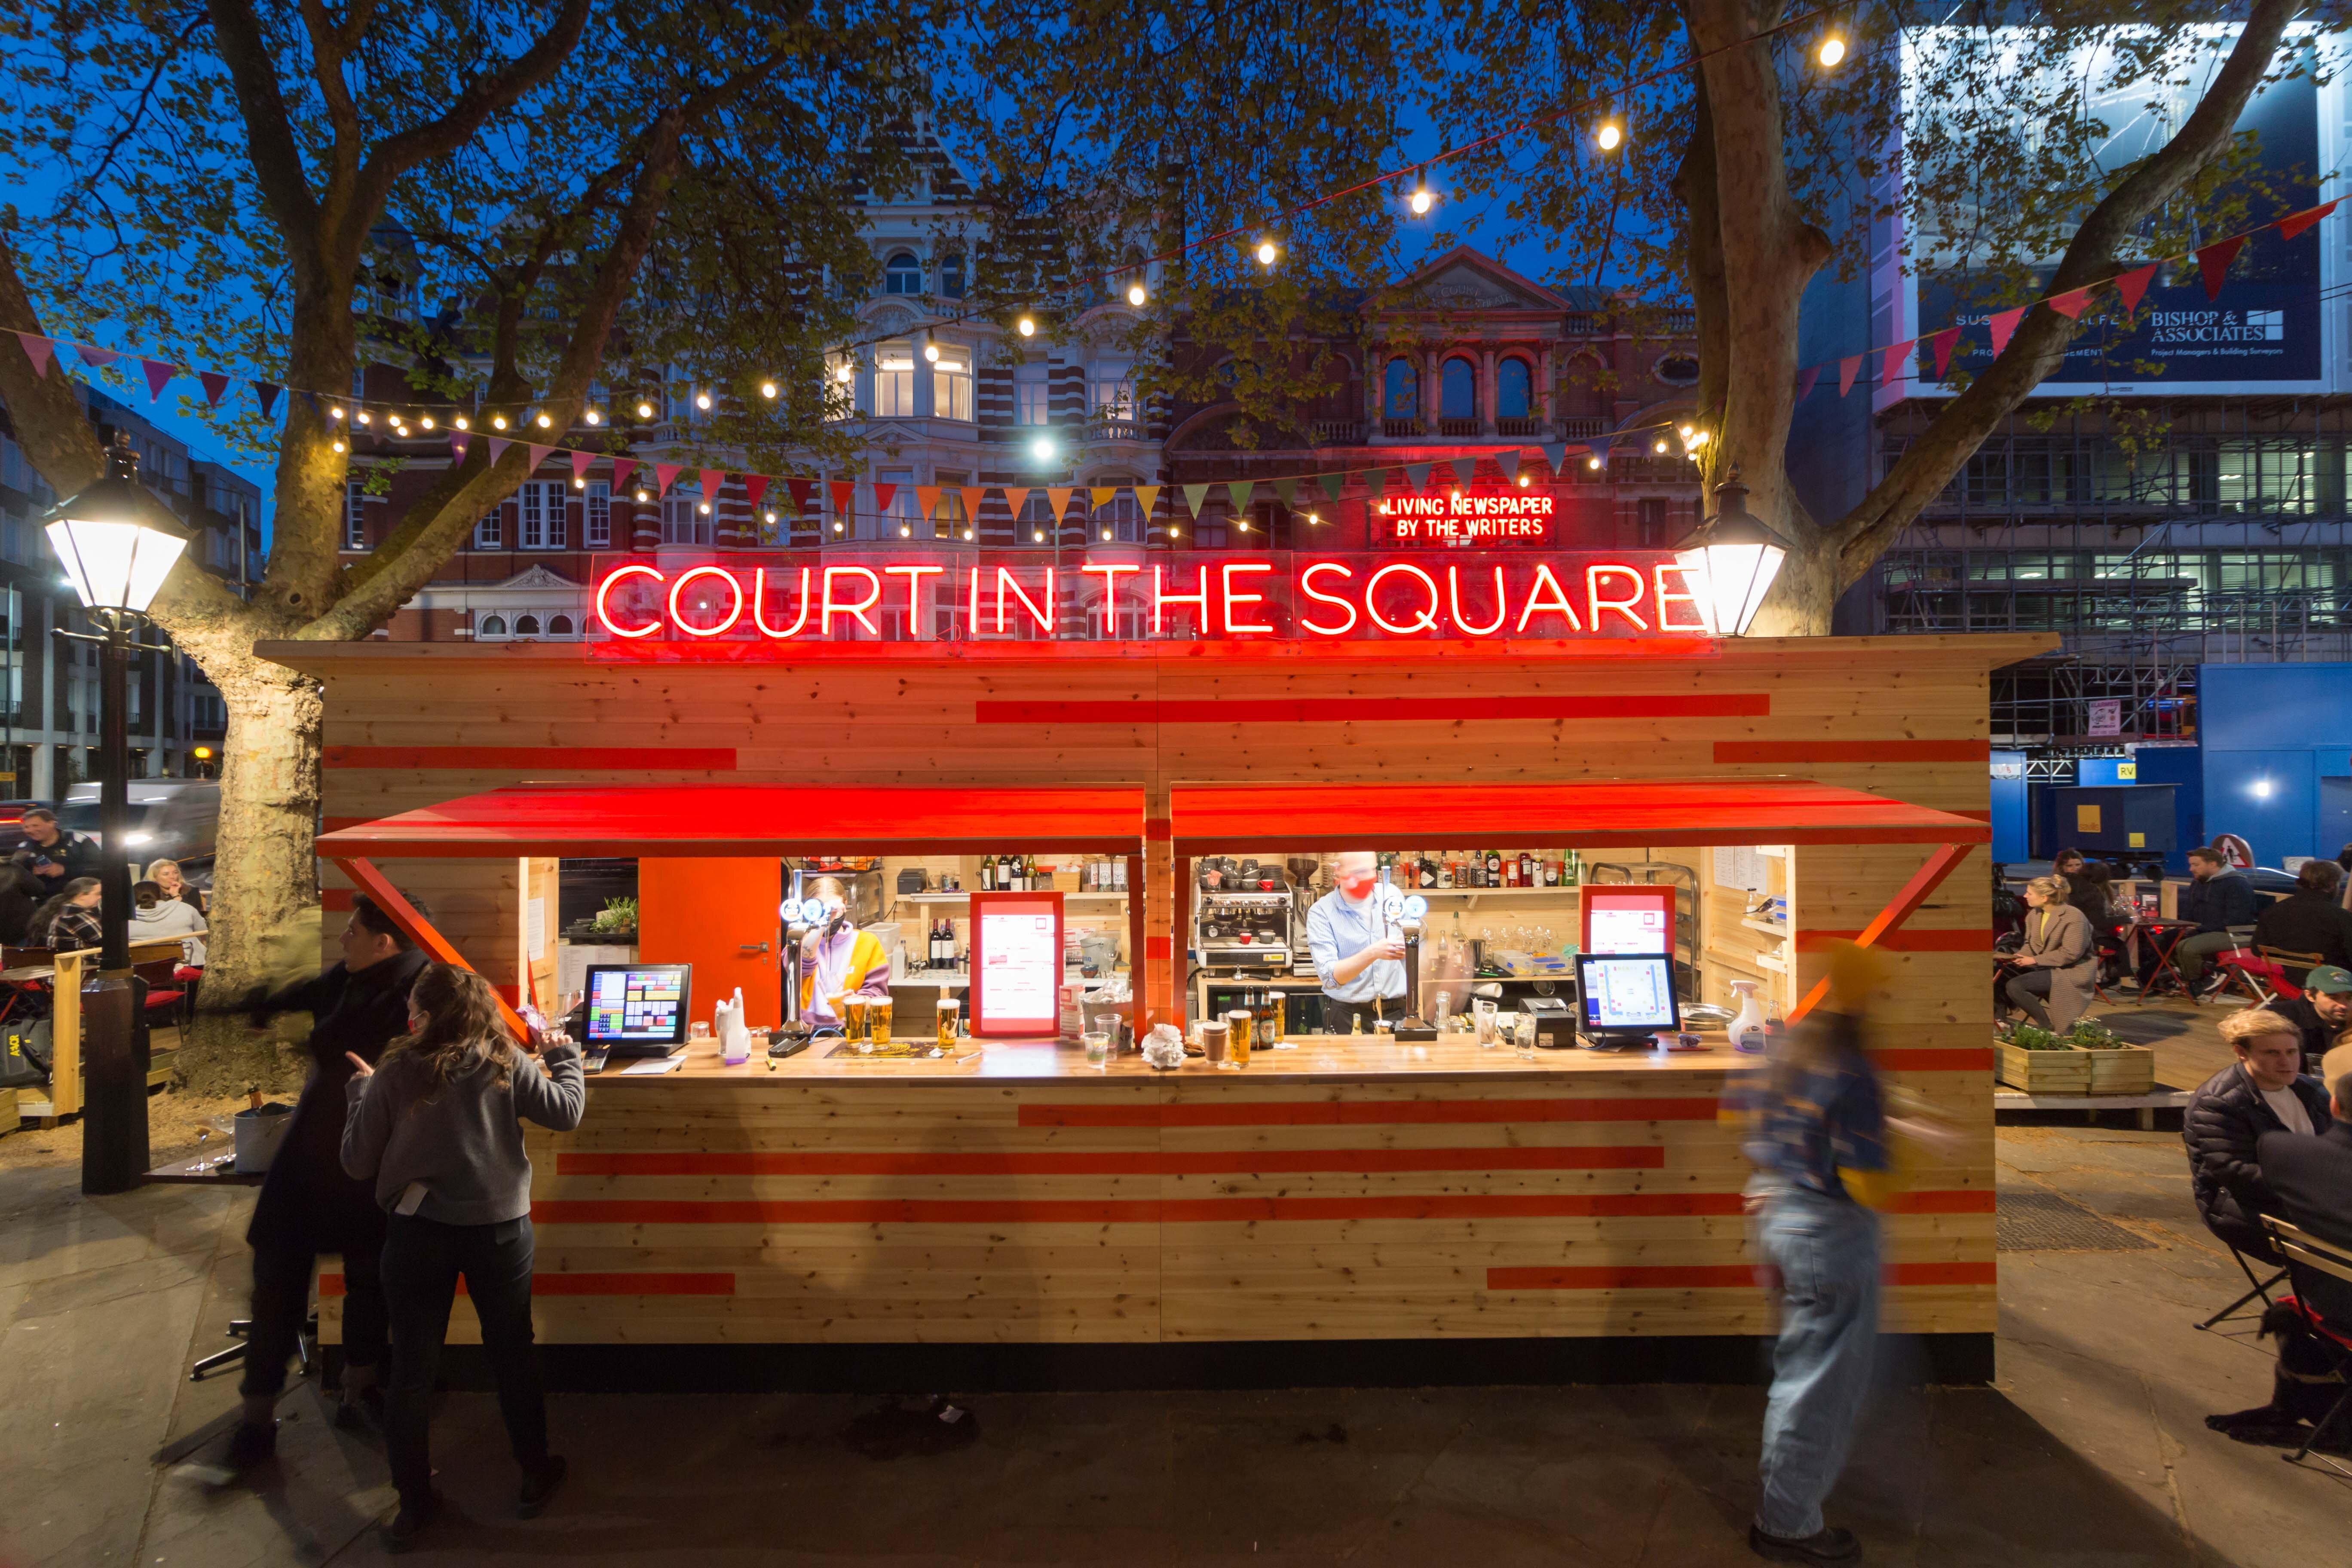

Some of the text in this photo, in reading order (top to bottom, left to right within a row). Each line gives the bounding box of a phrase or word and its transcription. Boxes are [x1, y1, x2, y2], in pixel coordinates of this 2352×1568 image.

[2151, 310, 2238, 327] BISHOP &
[2151, 326, 2264, 342] ASSOCIATES
[2151, 349, 2174, 357] Project
[2176, 348, 2211, 357] Managers
[2220, 347, 2248, 356] Building
[2249, 347, 2283, 356] Surveyors
[1386, 497, 1553, 515] LIVING NEWSPAPER
[1396, 518, 1543, 536] BY THE WRITERS
[596, 563, 1707, 638] COURT IN THE SQUARE
[2121, 767, 2134, 775] RV
